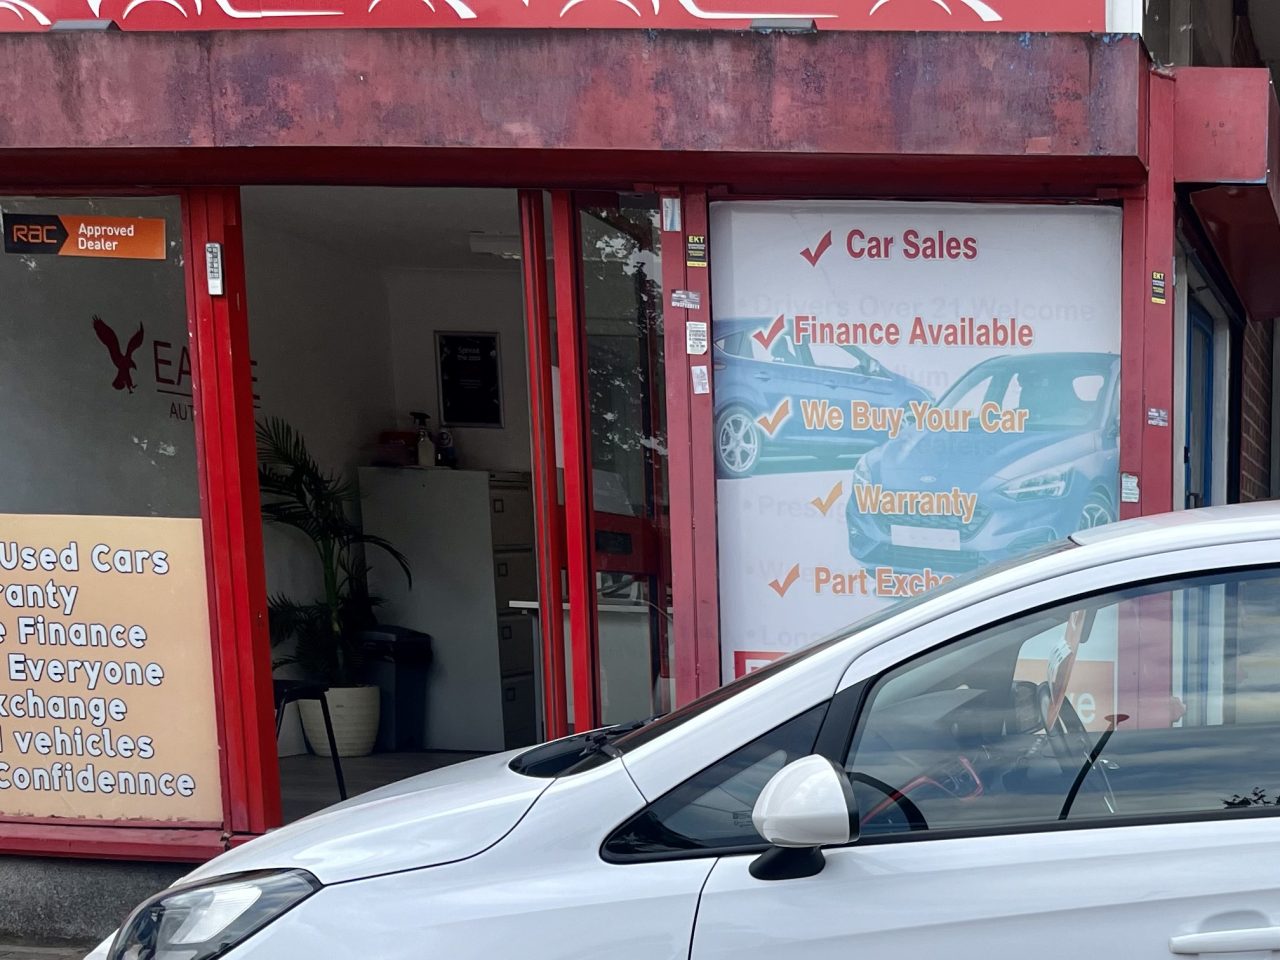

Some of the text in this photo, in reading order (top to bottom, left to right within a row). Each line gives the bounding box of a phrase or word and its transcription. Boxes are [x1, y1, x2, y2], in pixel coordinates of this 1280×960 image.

[78, 222, 135, 238] Approved
[78, 238, 118, 251] Dealer
[845, 228, 979, 261] Car Sales
[793, 314, 1035, 348] Finance Available
[800, 399, 1030, 439] We Buy Your Car
[853, 483, 978, 524] Warranty
[0, 541, 170, 575] Used Cars
[813, 566, 868, 596] Part
[17, 615, 148, 648] Finance
[8, 652, 165, 690] Everyone
[13, 726, 155, 759] vehicles
